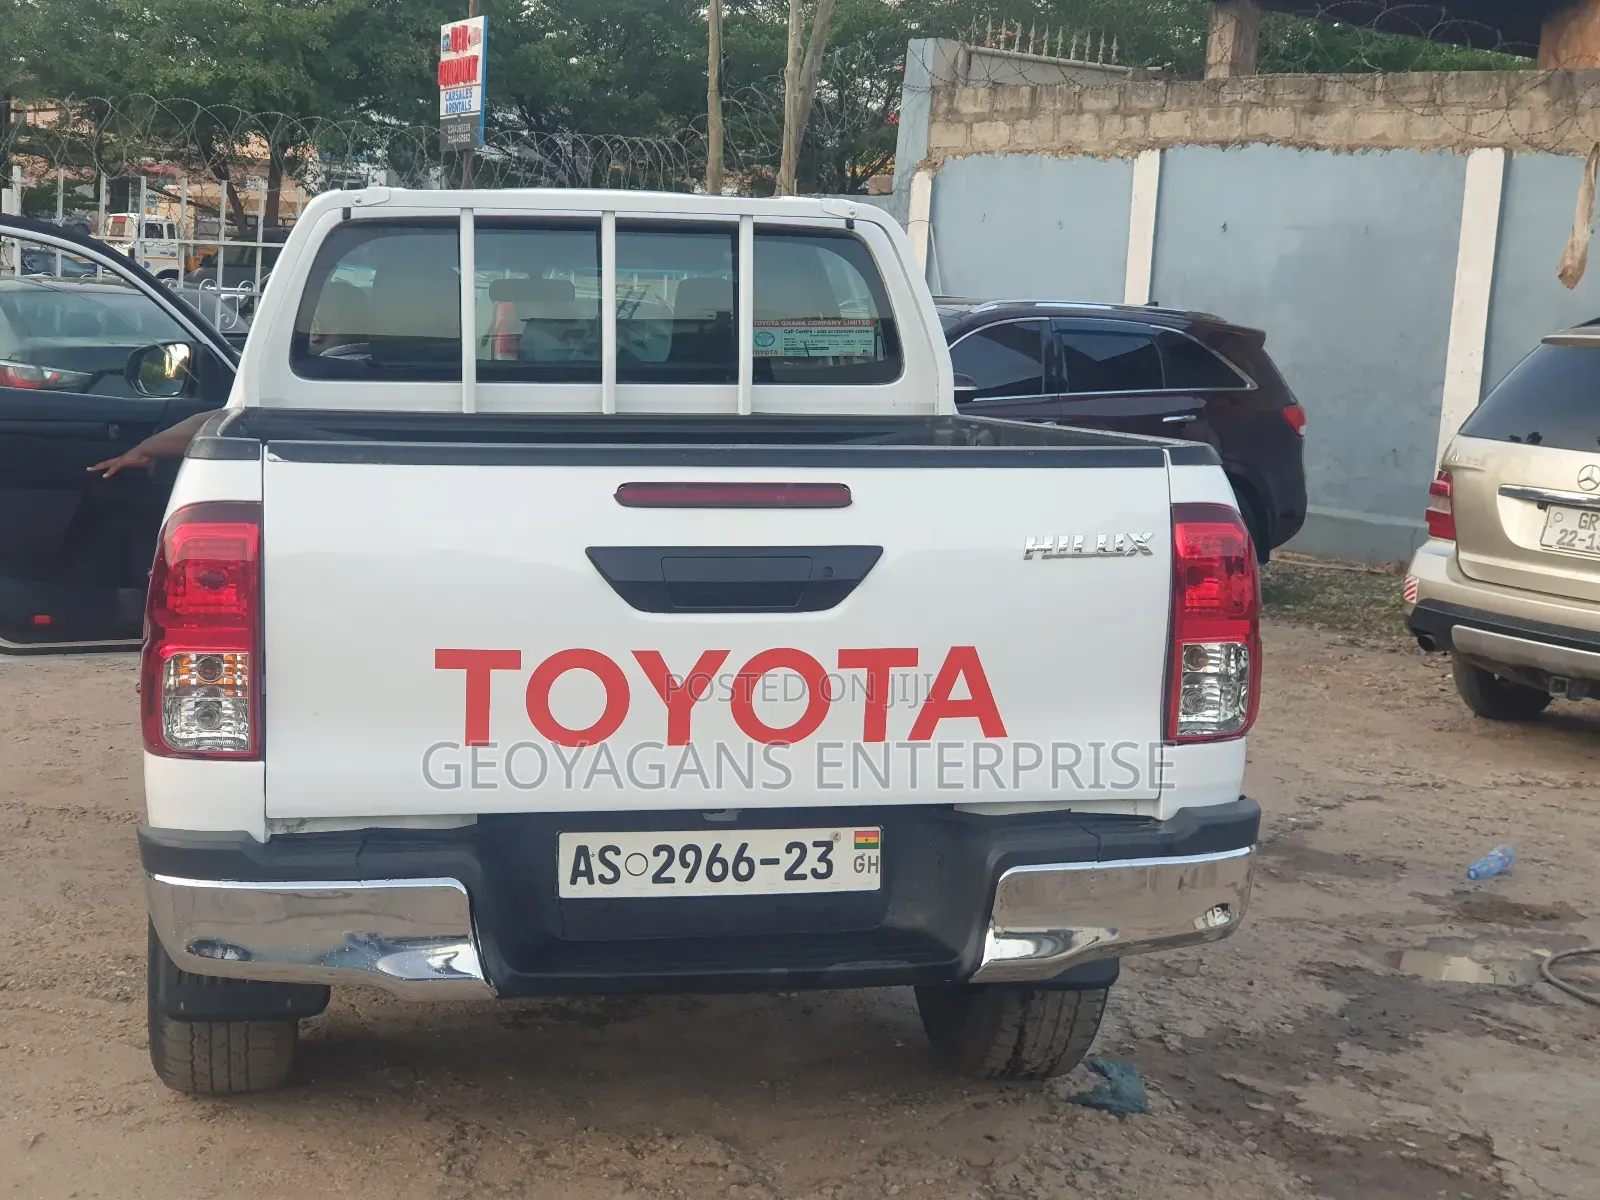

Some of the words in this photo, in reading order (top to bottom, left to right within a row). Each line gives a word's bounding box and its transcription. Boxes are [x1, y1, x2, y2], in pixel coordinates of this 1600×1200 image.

[1578, 512, 1600, 531] GR
[1023, 532, 1154, 560] HILUX
[434, 646, 1009, 747] TOYOTA
[853, 855, 879, 874] GH
